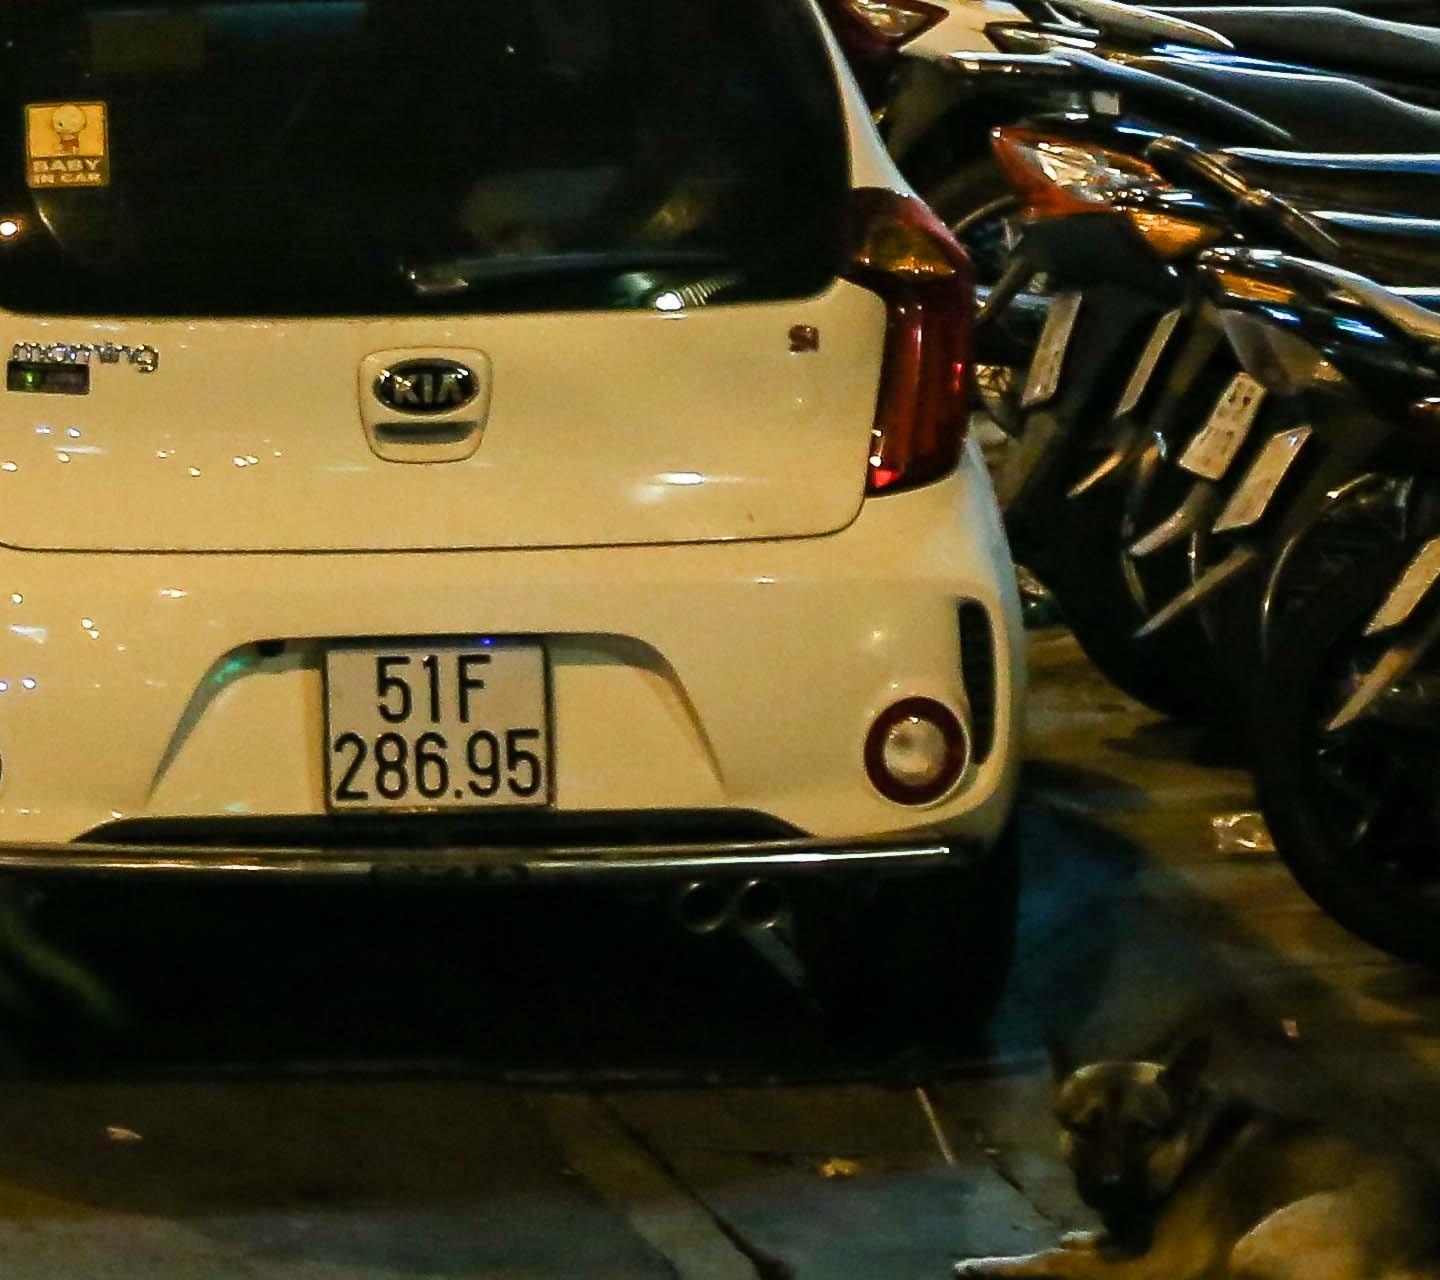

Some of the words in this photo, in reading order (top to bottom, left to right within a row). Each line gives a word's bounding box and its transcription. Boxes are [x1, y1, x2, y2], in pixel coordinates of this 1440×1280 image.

[32, 159, 101, 172] BABY
[33, 173, 55, 184] IN
[60, 173, 102, 184] CAR
[12, 341, 160, 374] morning
[374, 653, 492, 724] 51F
[333, 728, 543, 801] 286.95
